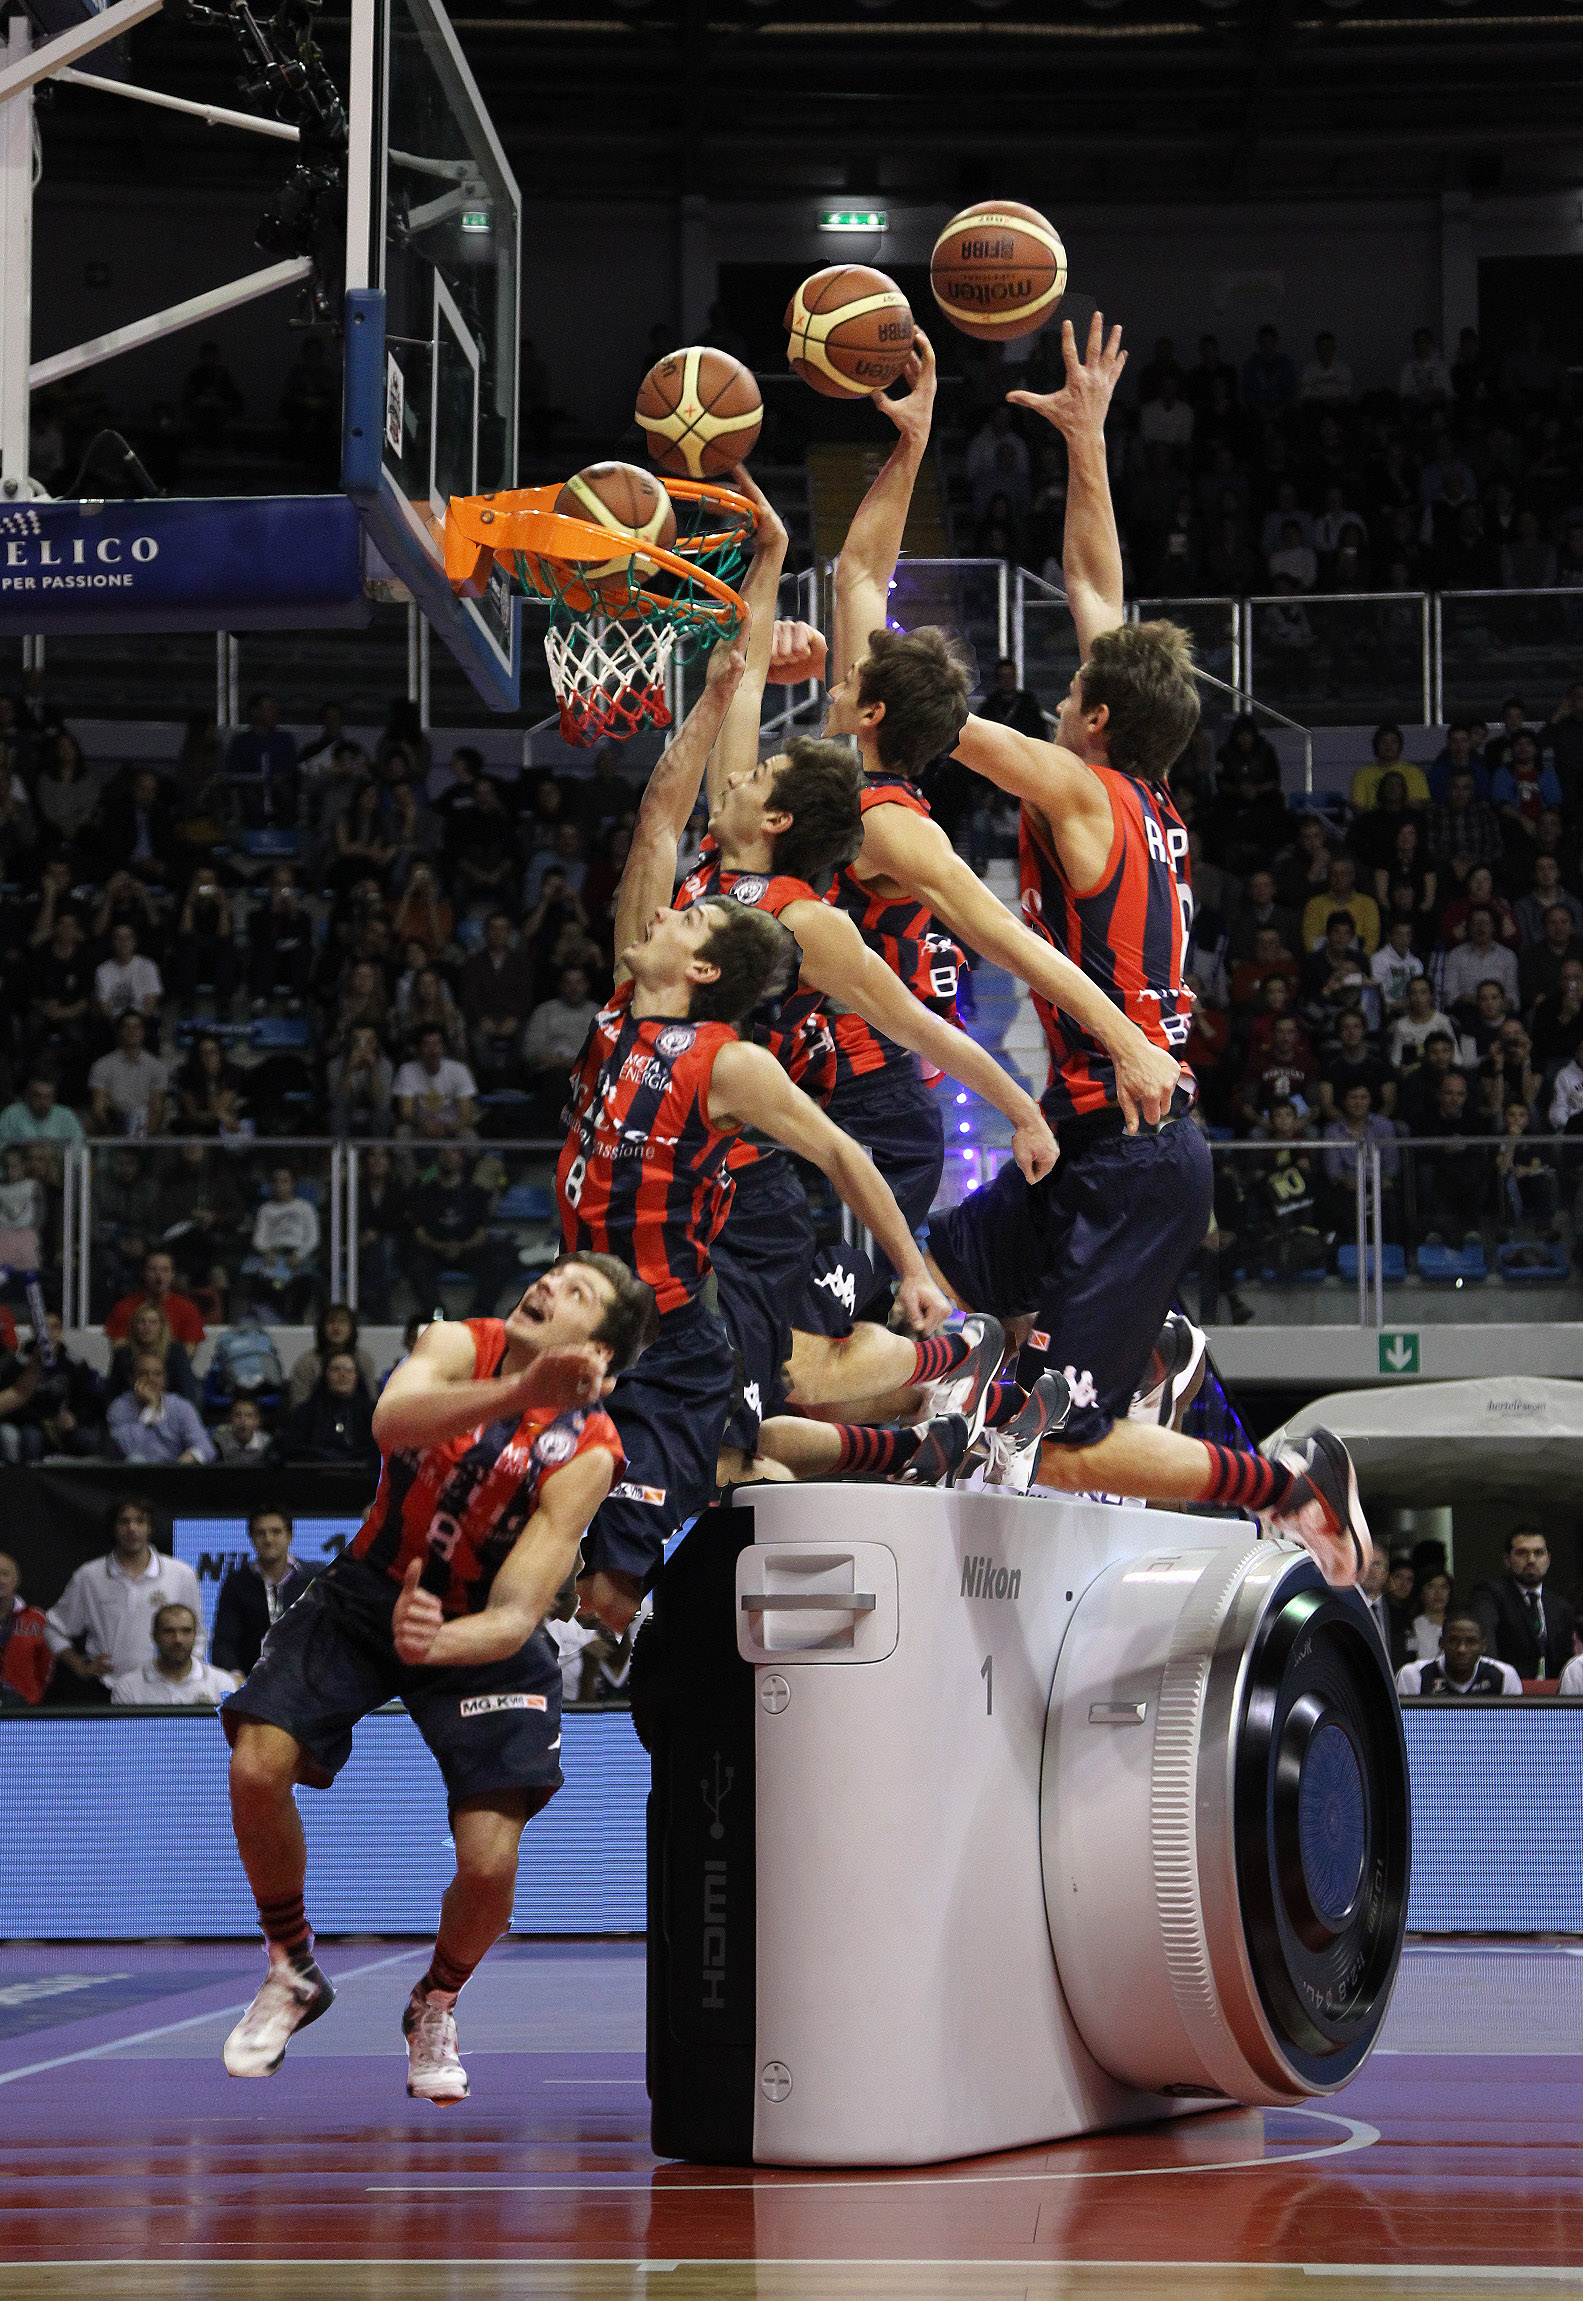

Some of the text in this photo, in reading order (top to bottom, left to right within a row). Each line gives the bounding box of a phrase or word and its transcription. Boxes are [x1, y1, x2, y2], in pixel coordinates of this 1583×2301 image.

[947, 280, 1032, 304] molten
[6, 536, 159, 566] ELICO
[2, 573, 134, 591] PER PASSIONE
[960, 1555, 1021, 1599] Nikon
[980, 1654, 993, 1716] 1
[702, 1860, 727, 2009] HDMI
